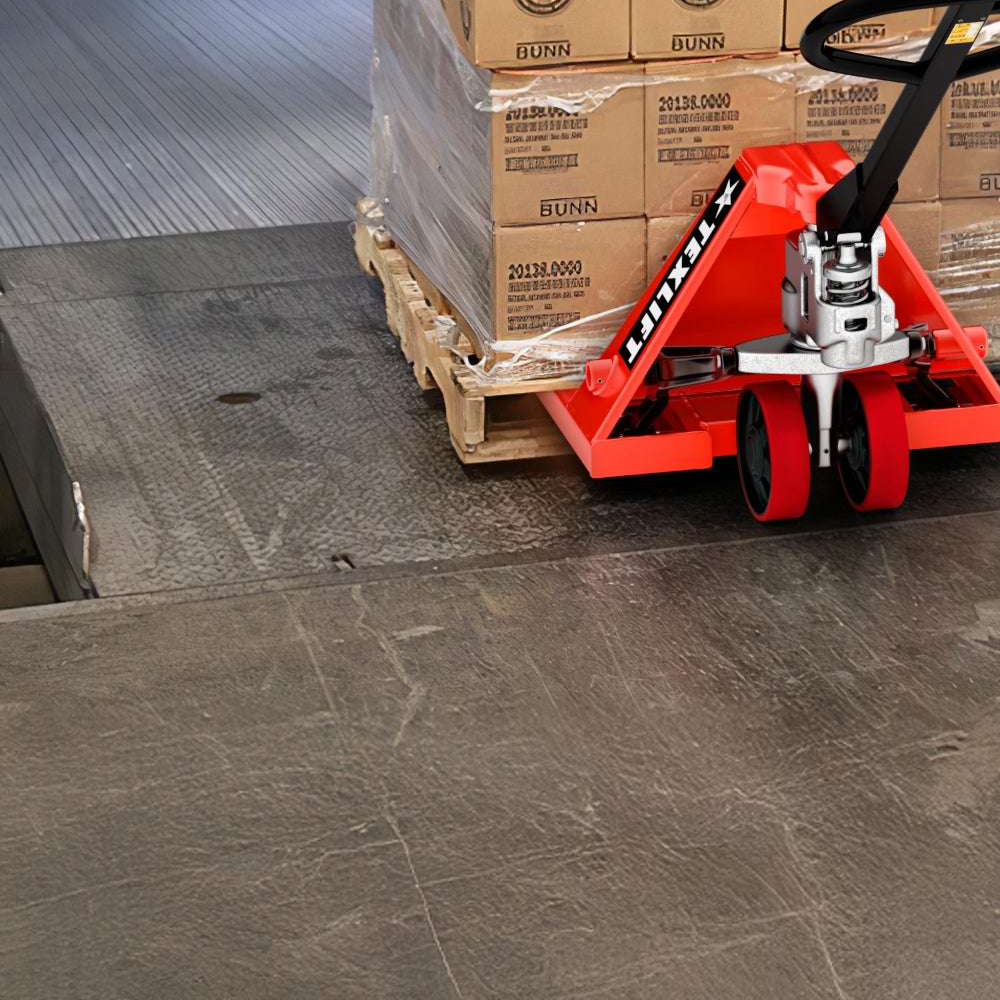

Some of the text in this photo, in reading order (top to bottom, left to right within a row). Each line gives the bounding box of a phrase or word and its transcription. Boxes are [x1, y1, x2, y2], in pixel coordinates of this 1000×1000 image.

[515, 43, 570, 59] BUNN
[539, 199, 596, 216] BUNN
[626, 218, 716, 365] TEXLIFT
